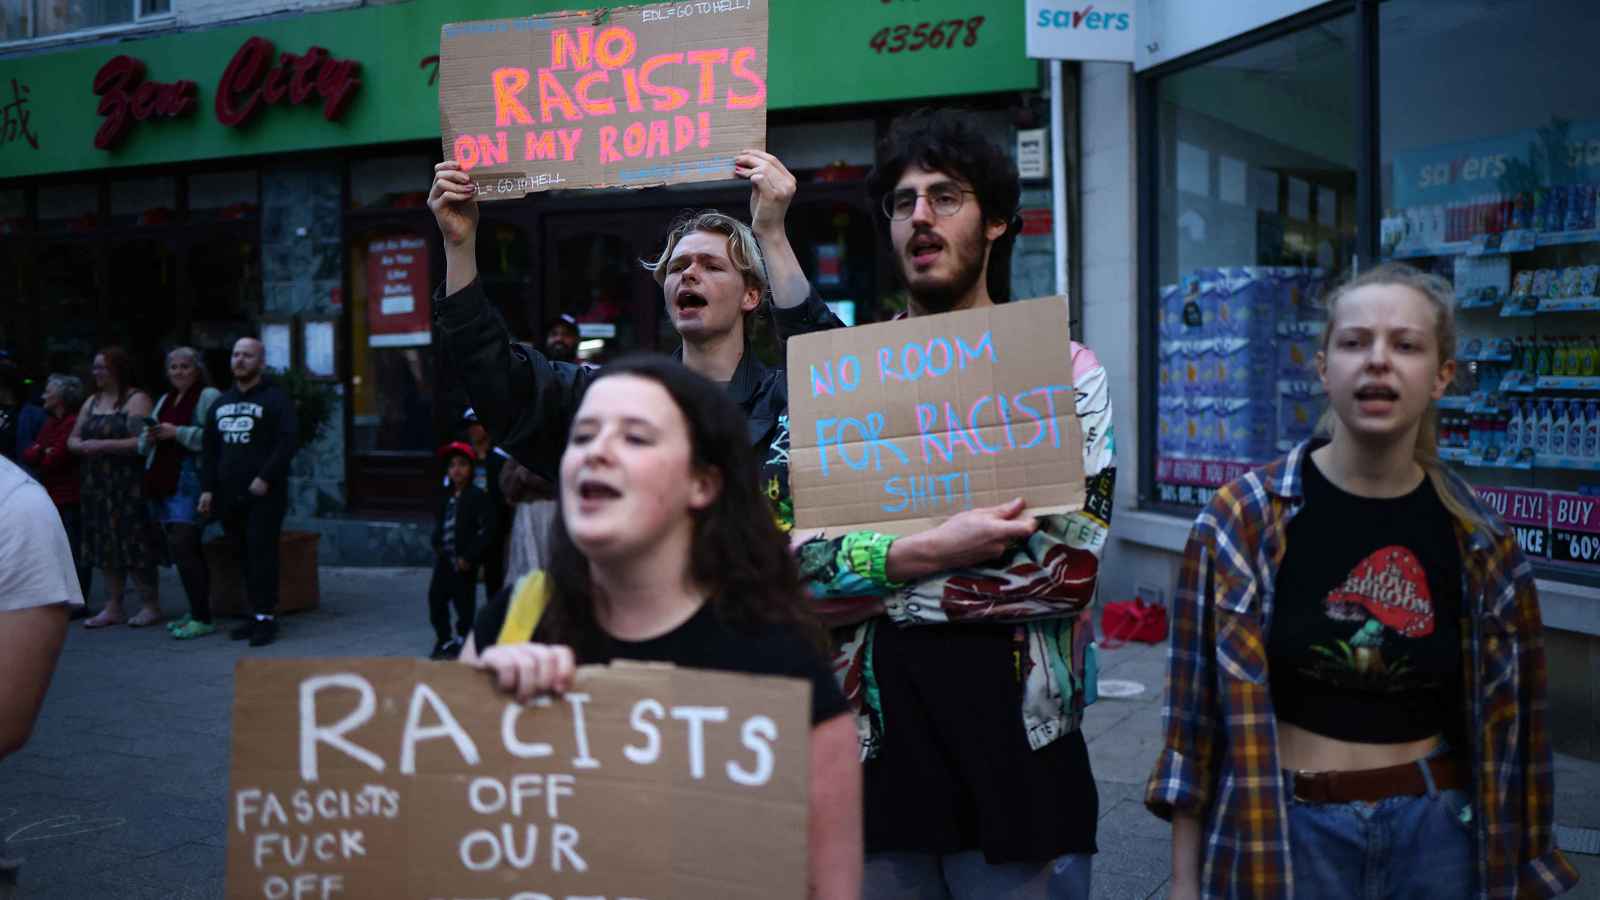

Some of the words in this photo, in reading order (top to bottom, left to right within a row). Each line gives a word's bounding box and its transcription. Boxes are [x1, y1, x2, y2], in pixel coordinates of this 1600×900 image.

[869, 16, 986, 54] 435678
[1037, 5, 1130, 31] savers
[550, 24, 637, 72] NO
[93, 53, 199, 150] Zen
[214, 36, 362, 125] City
[491, 46, 767, 127] RACISTS
[453, 131, 509, 172] ON
[524, 127, 582, 162] MY
[599, 112, 711, 166] ROAD!
[810, 354, 862, 400] NO
[879, 329, 999, 385] ROOM
[815, 410, 909, 477] FOR
[914, 384, 1073, 465] RACIST
[880, 472, 974, 514] SHIT!
[1513, 495, 1543, 519] FLY!
[1557, 499, 1594, 526] BUY
[299, 672, 779, 786] RACISTS
[235, 784, 400, 832] FASCISTS
[468, 774, 576, 818] OFF
[254, 829, 367, 868] FUCK
[459, 823, 588, 872] OUR
[263, 874, 344, 900] OFF
